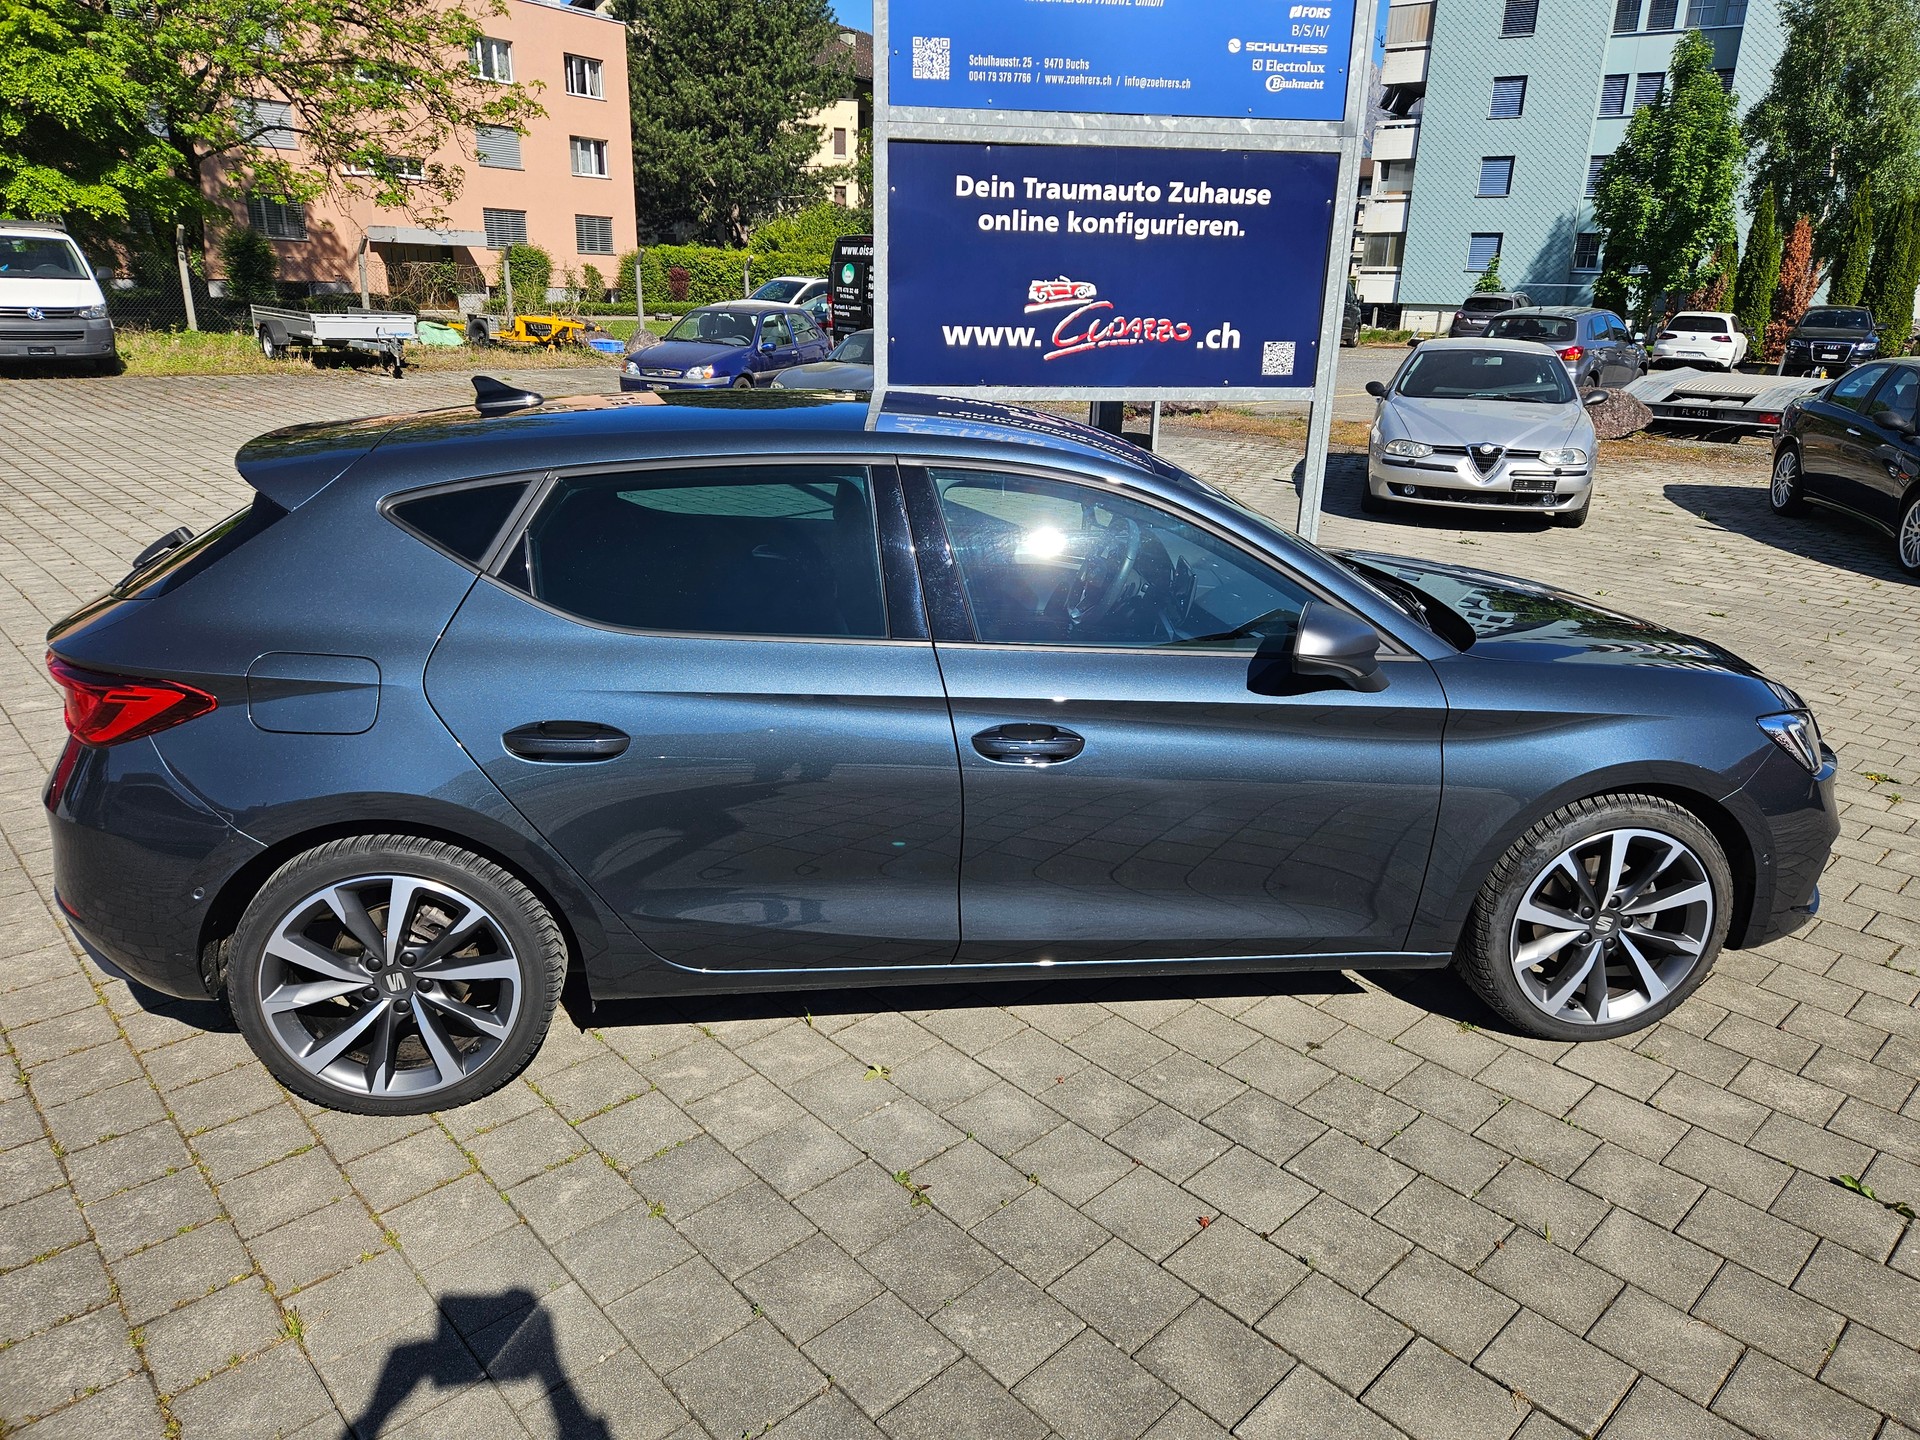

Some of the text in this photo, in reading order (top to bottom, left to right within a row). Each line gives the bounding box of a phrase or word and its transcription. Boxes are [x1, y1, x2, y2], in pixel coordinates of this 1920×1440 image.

[1302, 6, 1332, 19] FORS
[1292, 24, 1330, 39] B/S/H/
[1245, 41, 1329, 55] SCHULTHESS
[968, 54, 1021, 68] Schulhausstr.
[1022, 56, 1033, 68] 25
[1044, 57, 1064, 69] 9470
[1065, 58, 1090, 70] Buchs
[1266, 59, 1326, 74] Electrolux
[968, 70, 986, 82] 0041
[987, 71, 997, 82] 79
[998, 72, 1012, 82] 378
[1013, 72, 1032, 83] 7766
[1044, 73, 1112, 86] www.zoehrers.ch
[1124, 75, 1191, 89] info@zoehrers.ch
[1269, 76, 1325, 91] Bauknecht
[955, 173, 1272, 206] Dein Traumauto Zuhause
[978, 209, 1246, 241] online konfigurieren.
[1681, 408, 1709, 417] FL 611
